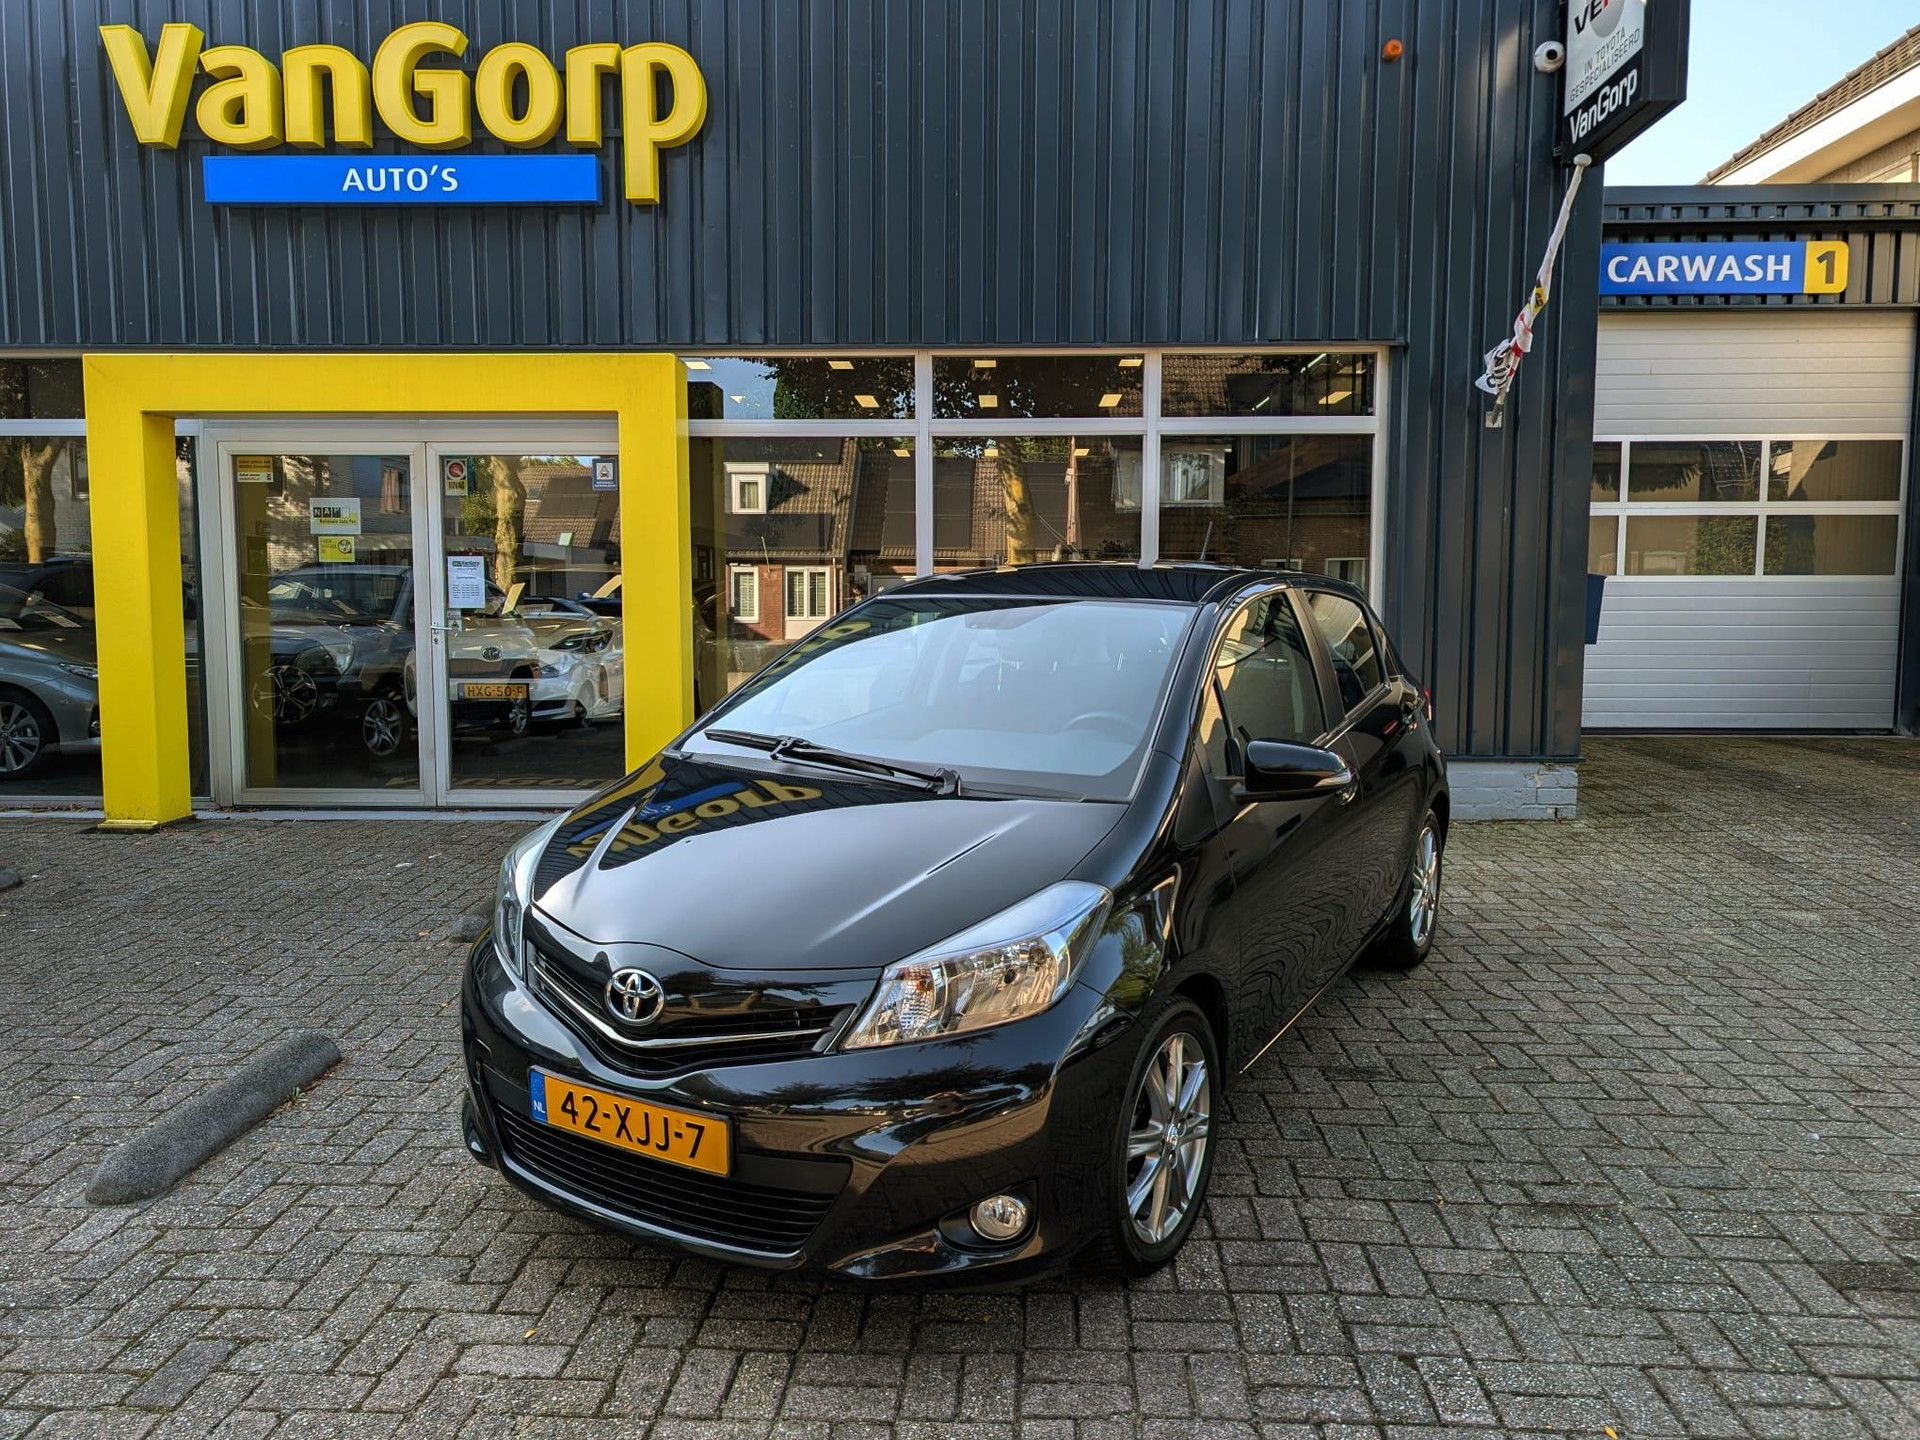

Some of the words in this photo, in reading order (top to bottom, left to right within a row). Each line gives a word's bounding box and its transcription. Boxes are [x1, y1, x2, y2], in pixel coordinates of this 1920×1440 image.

[1574, 0, 1609, 35] VE
[1570, 28, 1640, 102] GESPECIALISEERD
[1584, 57, 1593, 75] IN
[1596, 27, 1626, 60] TOYOTA
[99, 21, 708, 205] VanGorp
[1570, 68, 1638, 144] VanGorp
[342, 166, 459, 192] AUTO'S
[1607, 255, 1791, 283] CARWASH
[1815, 250, 1837, 284] 1
[467, 686, 523, 697] HXG-50-F
[533, 1100, 546, 1114] NL
[560, 1090, 706, 1159] 42-XJJ-7
